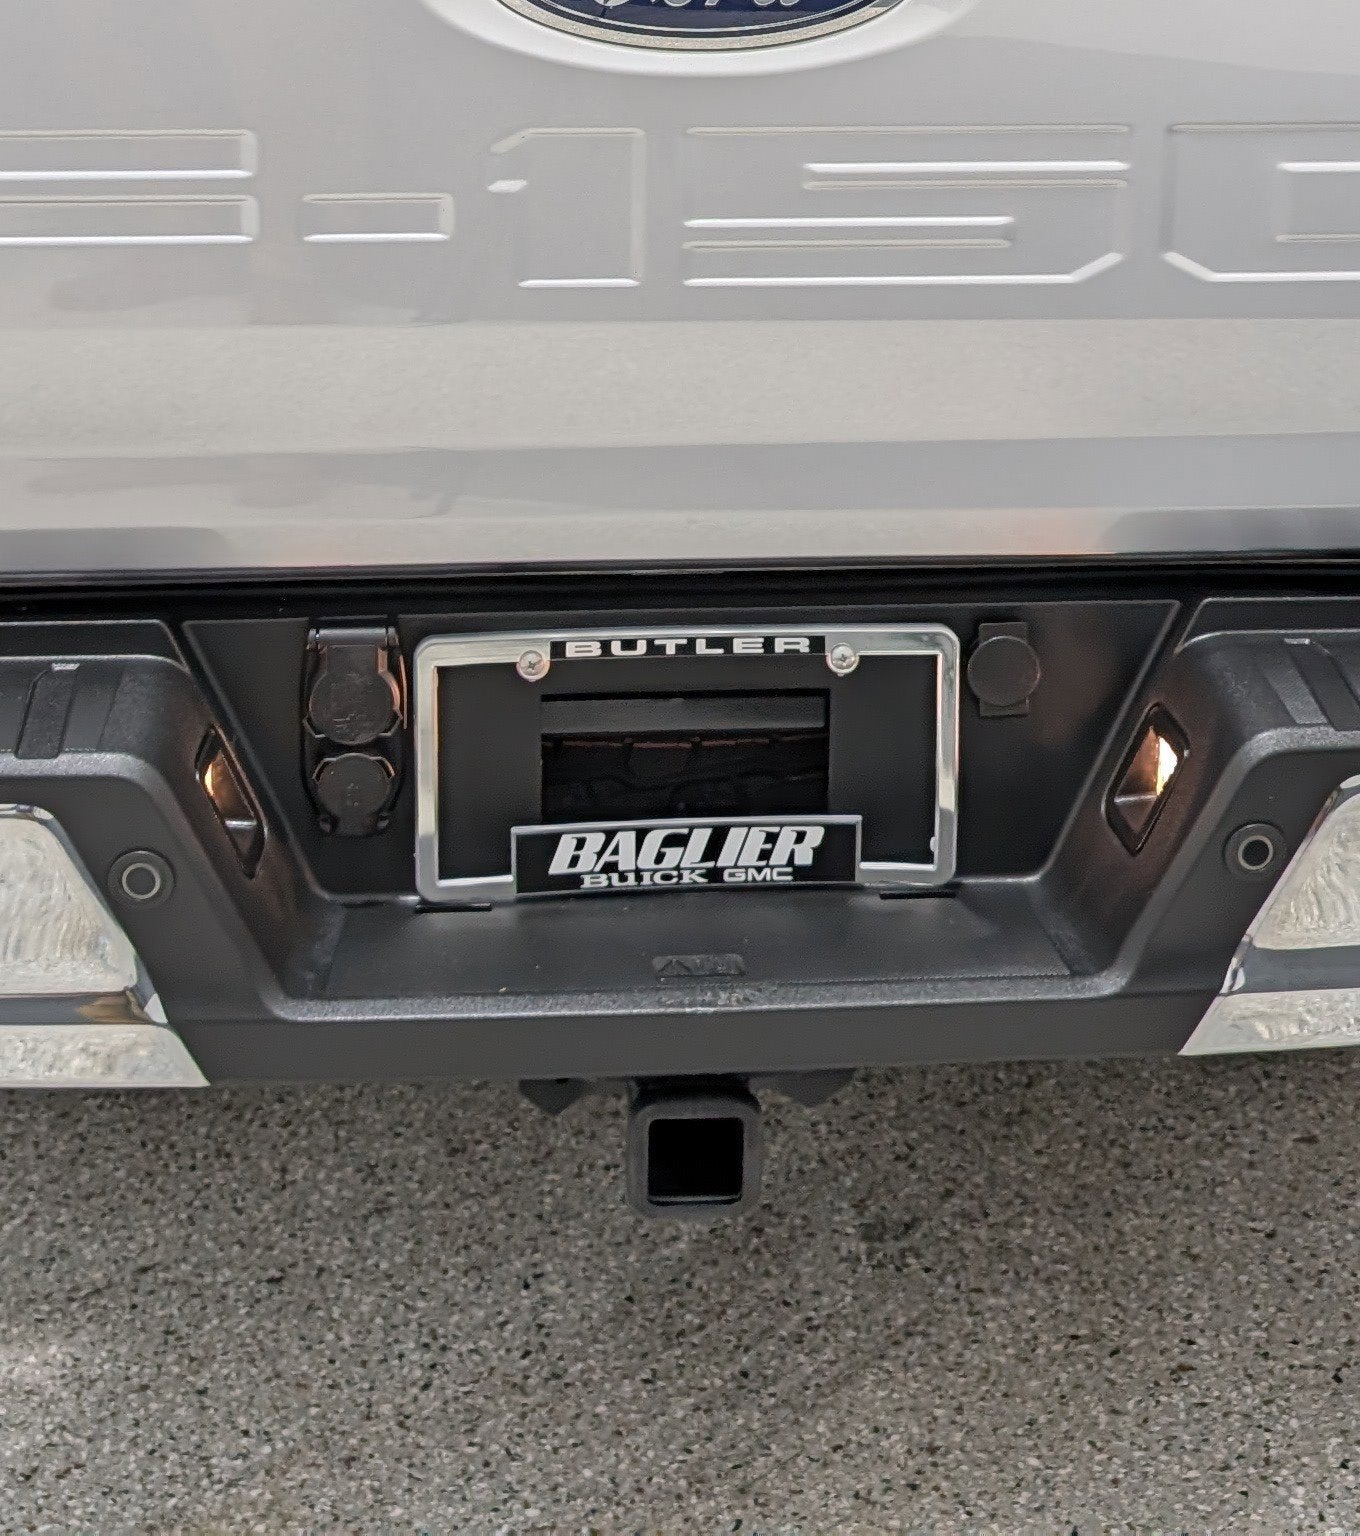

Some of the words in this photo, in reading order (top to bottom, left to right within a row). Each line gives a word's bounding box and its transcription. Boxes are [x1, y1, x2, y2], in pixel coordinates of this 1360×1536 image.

[564, 636, 811, 658] BUTLER
[548, 825, 826, 876] BAGLIER
[580, 867, 709, 889] BUICK
[722, 866, 794, 883] GMC
